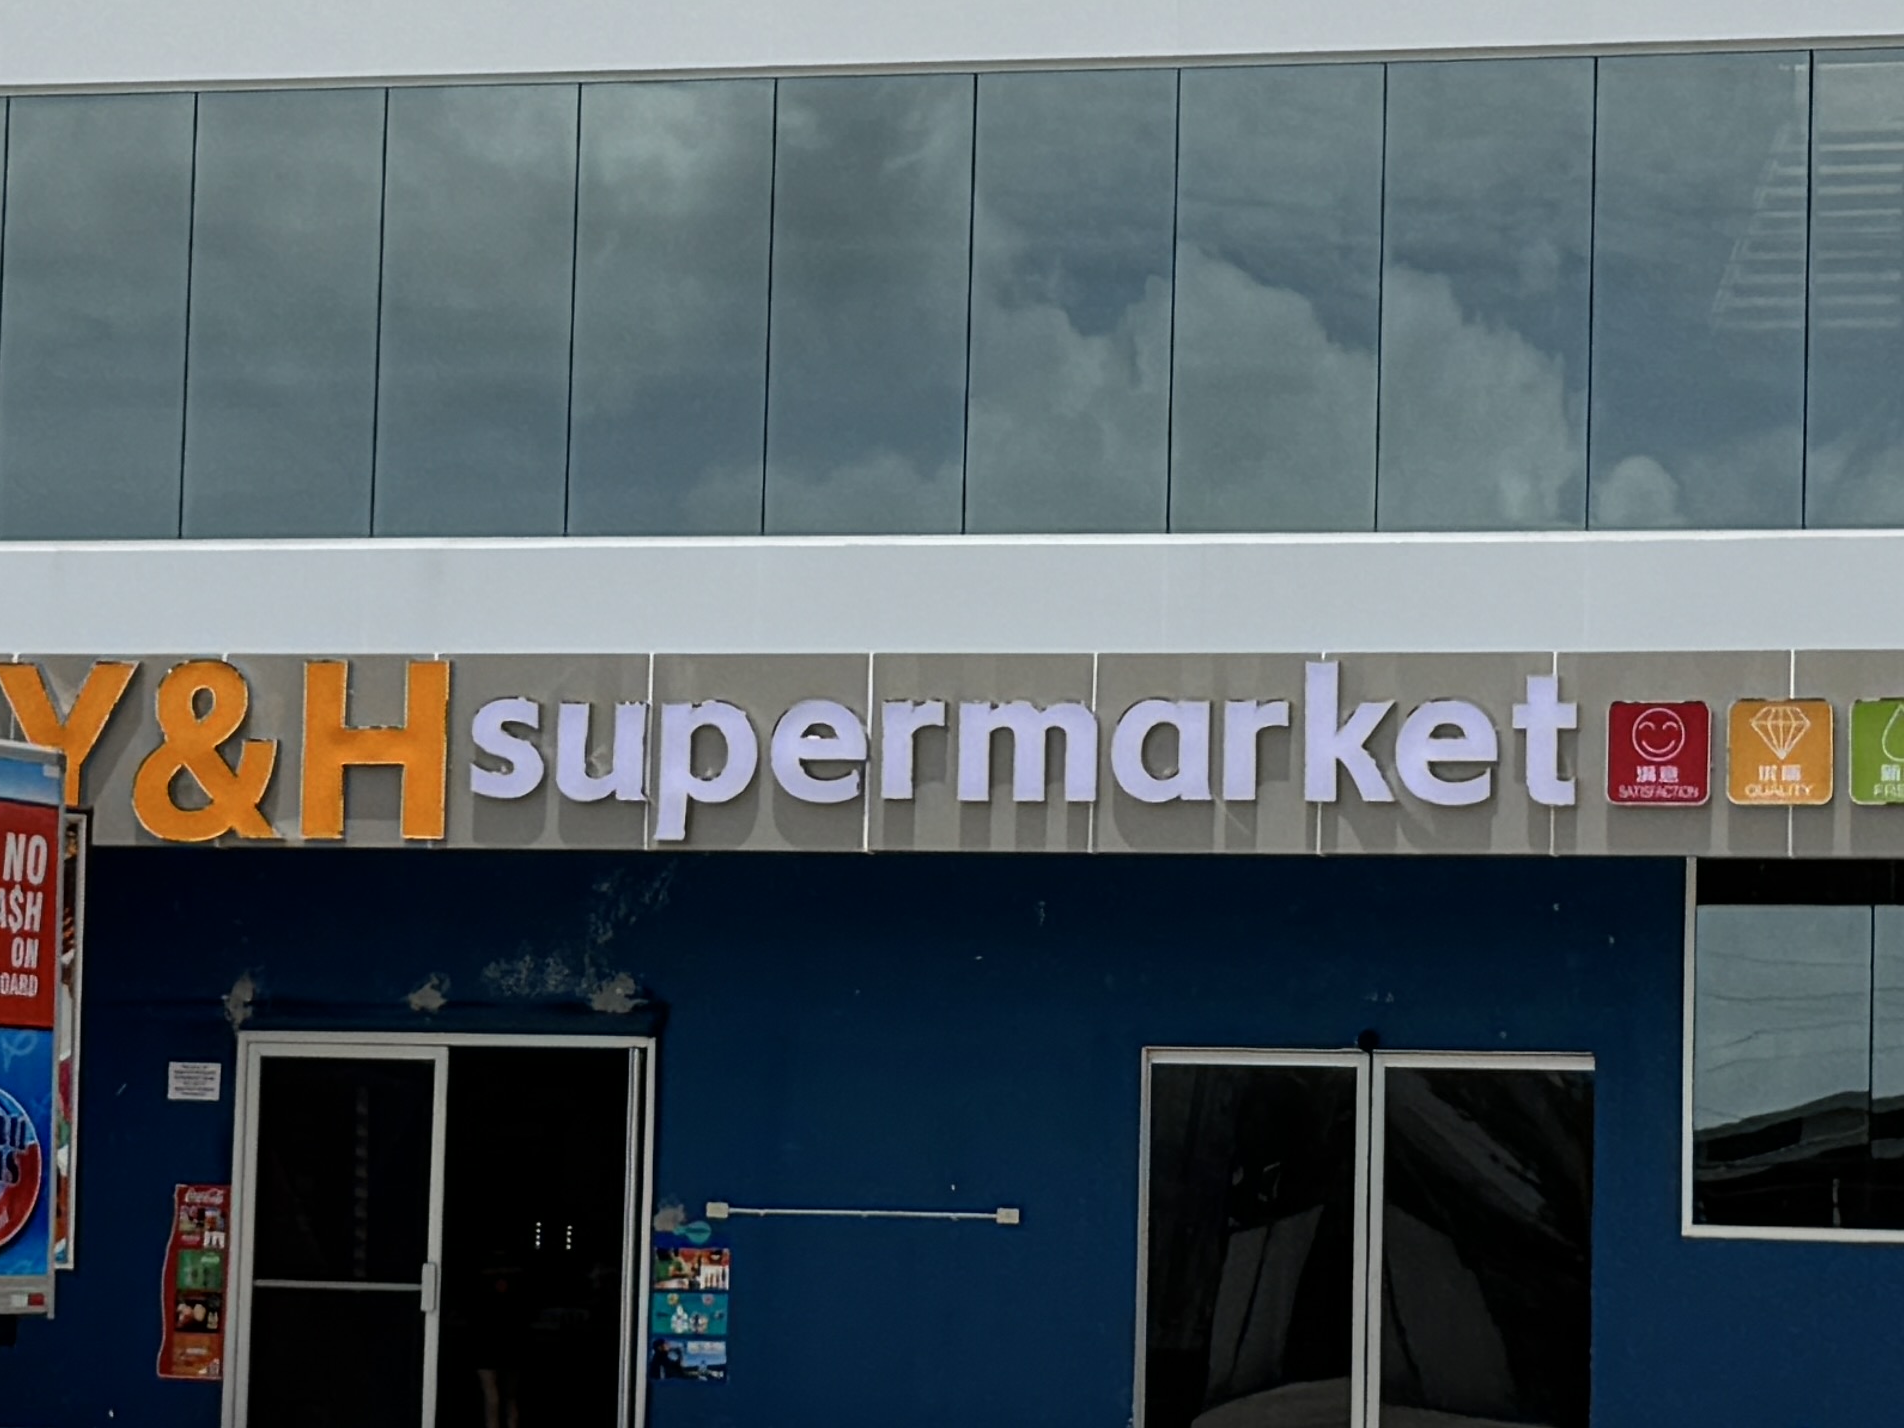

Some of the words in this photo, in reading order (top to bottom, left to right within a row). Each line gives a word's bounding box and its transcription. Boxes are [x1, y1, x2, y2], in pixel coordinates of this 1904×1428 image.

[469, 660, 1578, 841] supermarket
[1618, 784, 1699, 800] SATISFACTION
[1745, 783, 1814, 797] QUALITY
[2, 832, 47, 885] NO
[10, 937, 39, 969] ON
